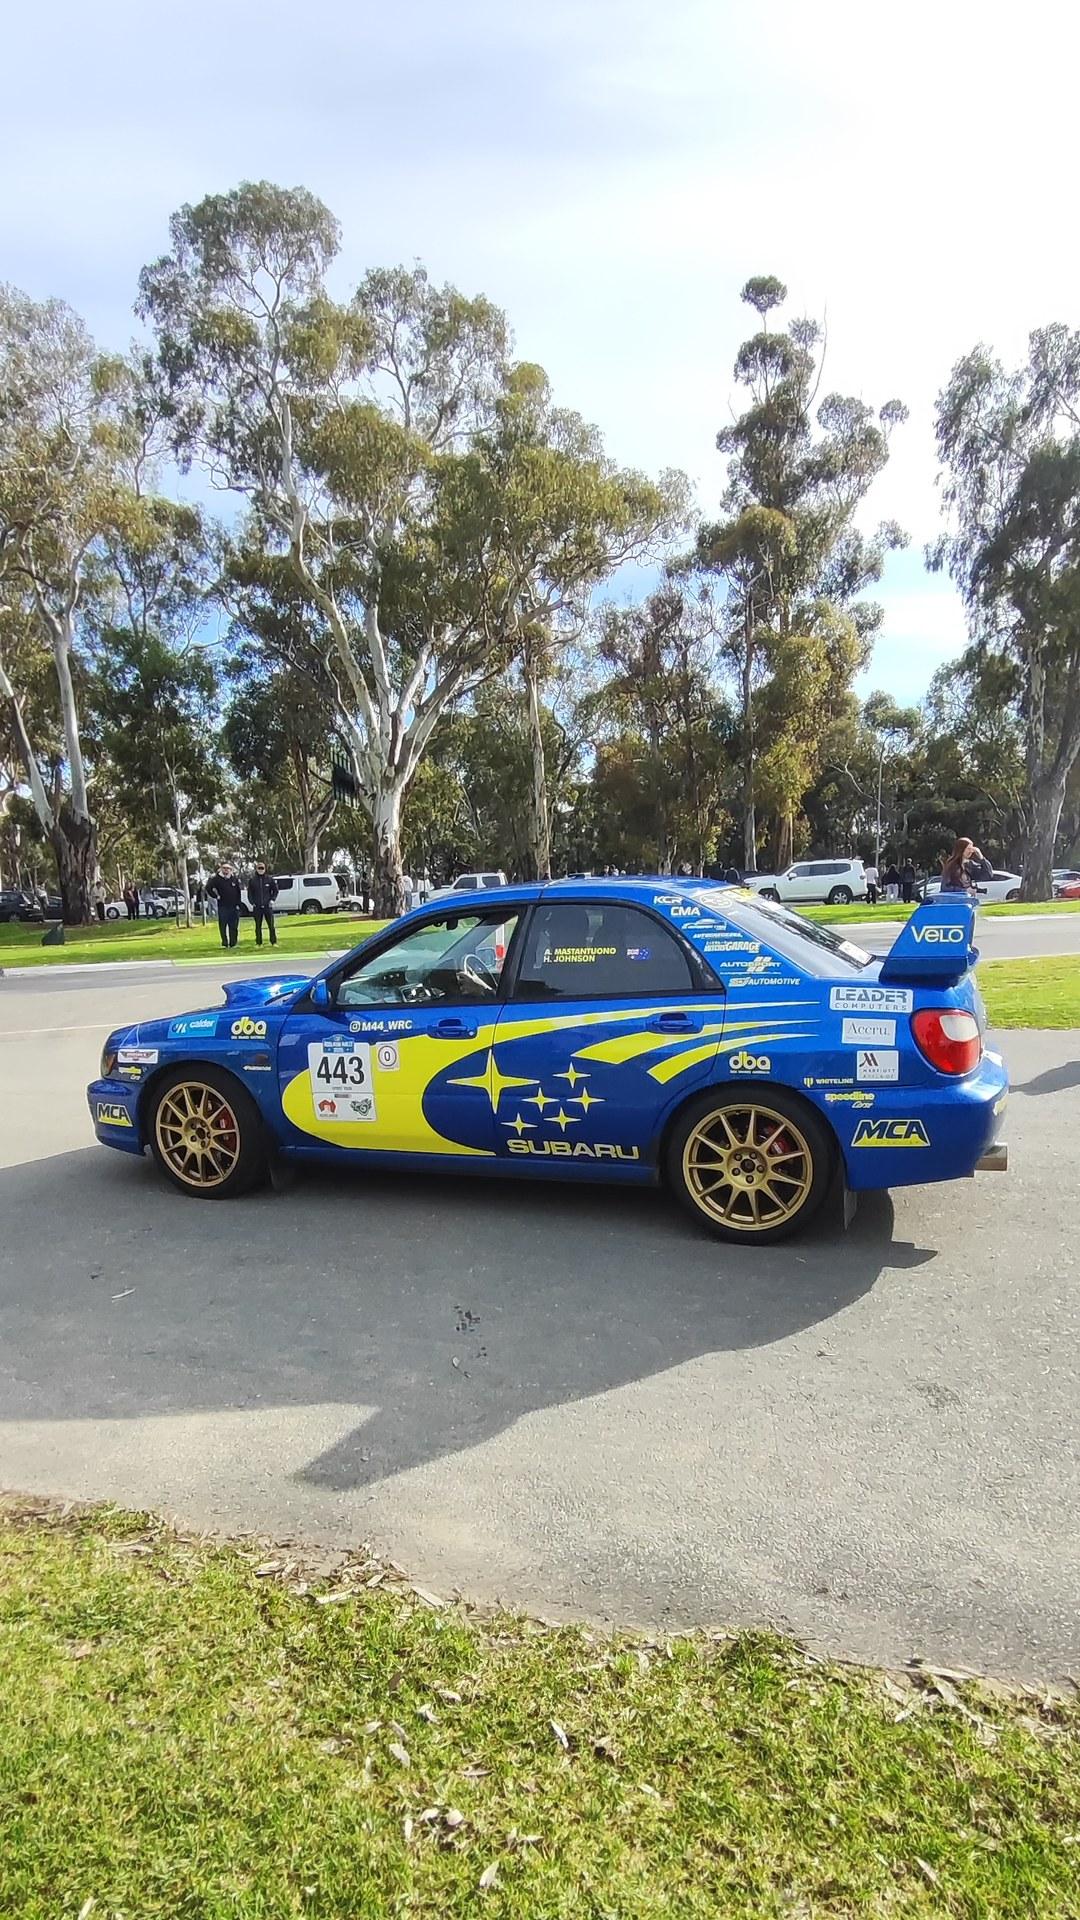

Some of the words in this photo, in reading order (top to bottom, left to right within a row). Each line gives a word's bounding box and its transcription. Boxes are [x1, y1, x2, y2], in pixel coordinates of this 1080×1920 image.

[654, 896, 682, 905] KCR
[671, 907, 700, 916] CMA
[554, 947, 617, 955] MASTANTUONO
[543, 955, 552, 963] H.
[553, 955, 596, 963] JOHNSON
[748, 978, 800, 986] AUTOMOTIVE
[835, 989, 908, 1004] LEADER
[834, 1002, 908, 1011] COMPUTERS
[231, 1016, 267, 1035] dba
[729, 1051, 771, 1070] dba
[317, 1056, 365, 1085] 443
[99, 1103, 131, 1122] MCA
[853, 1120, 928, 1144] MCA
[507, 1139, 640, 1160] SUBARU
